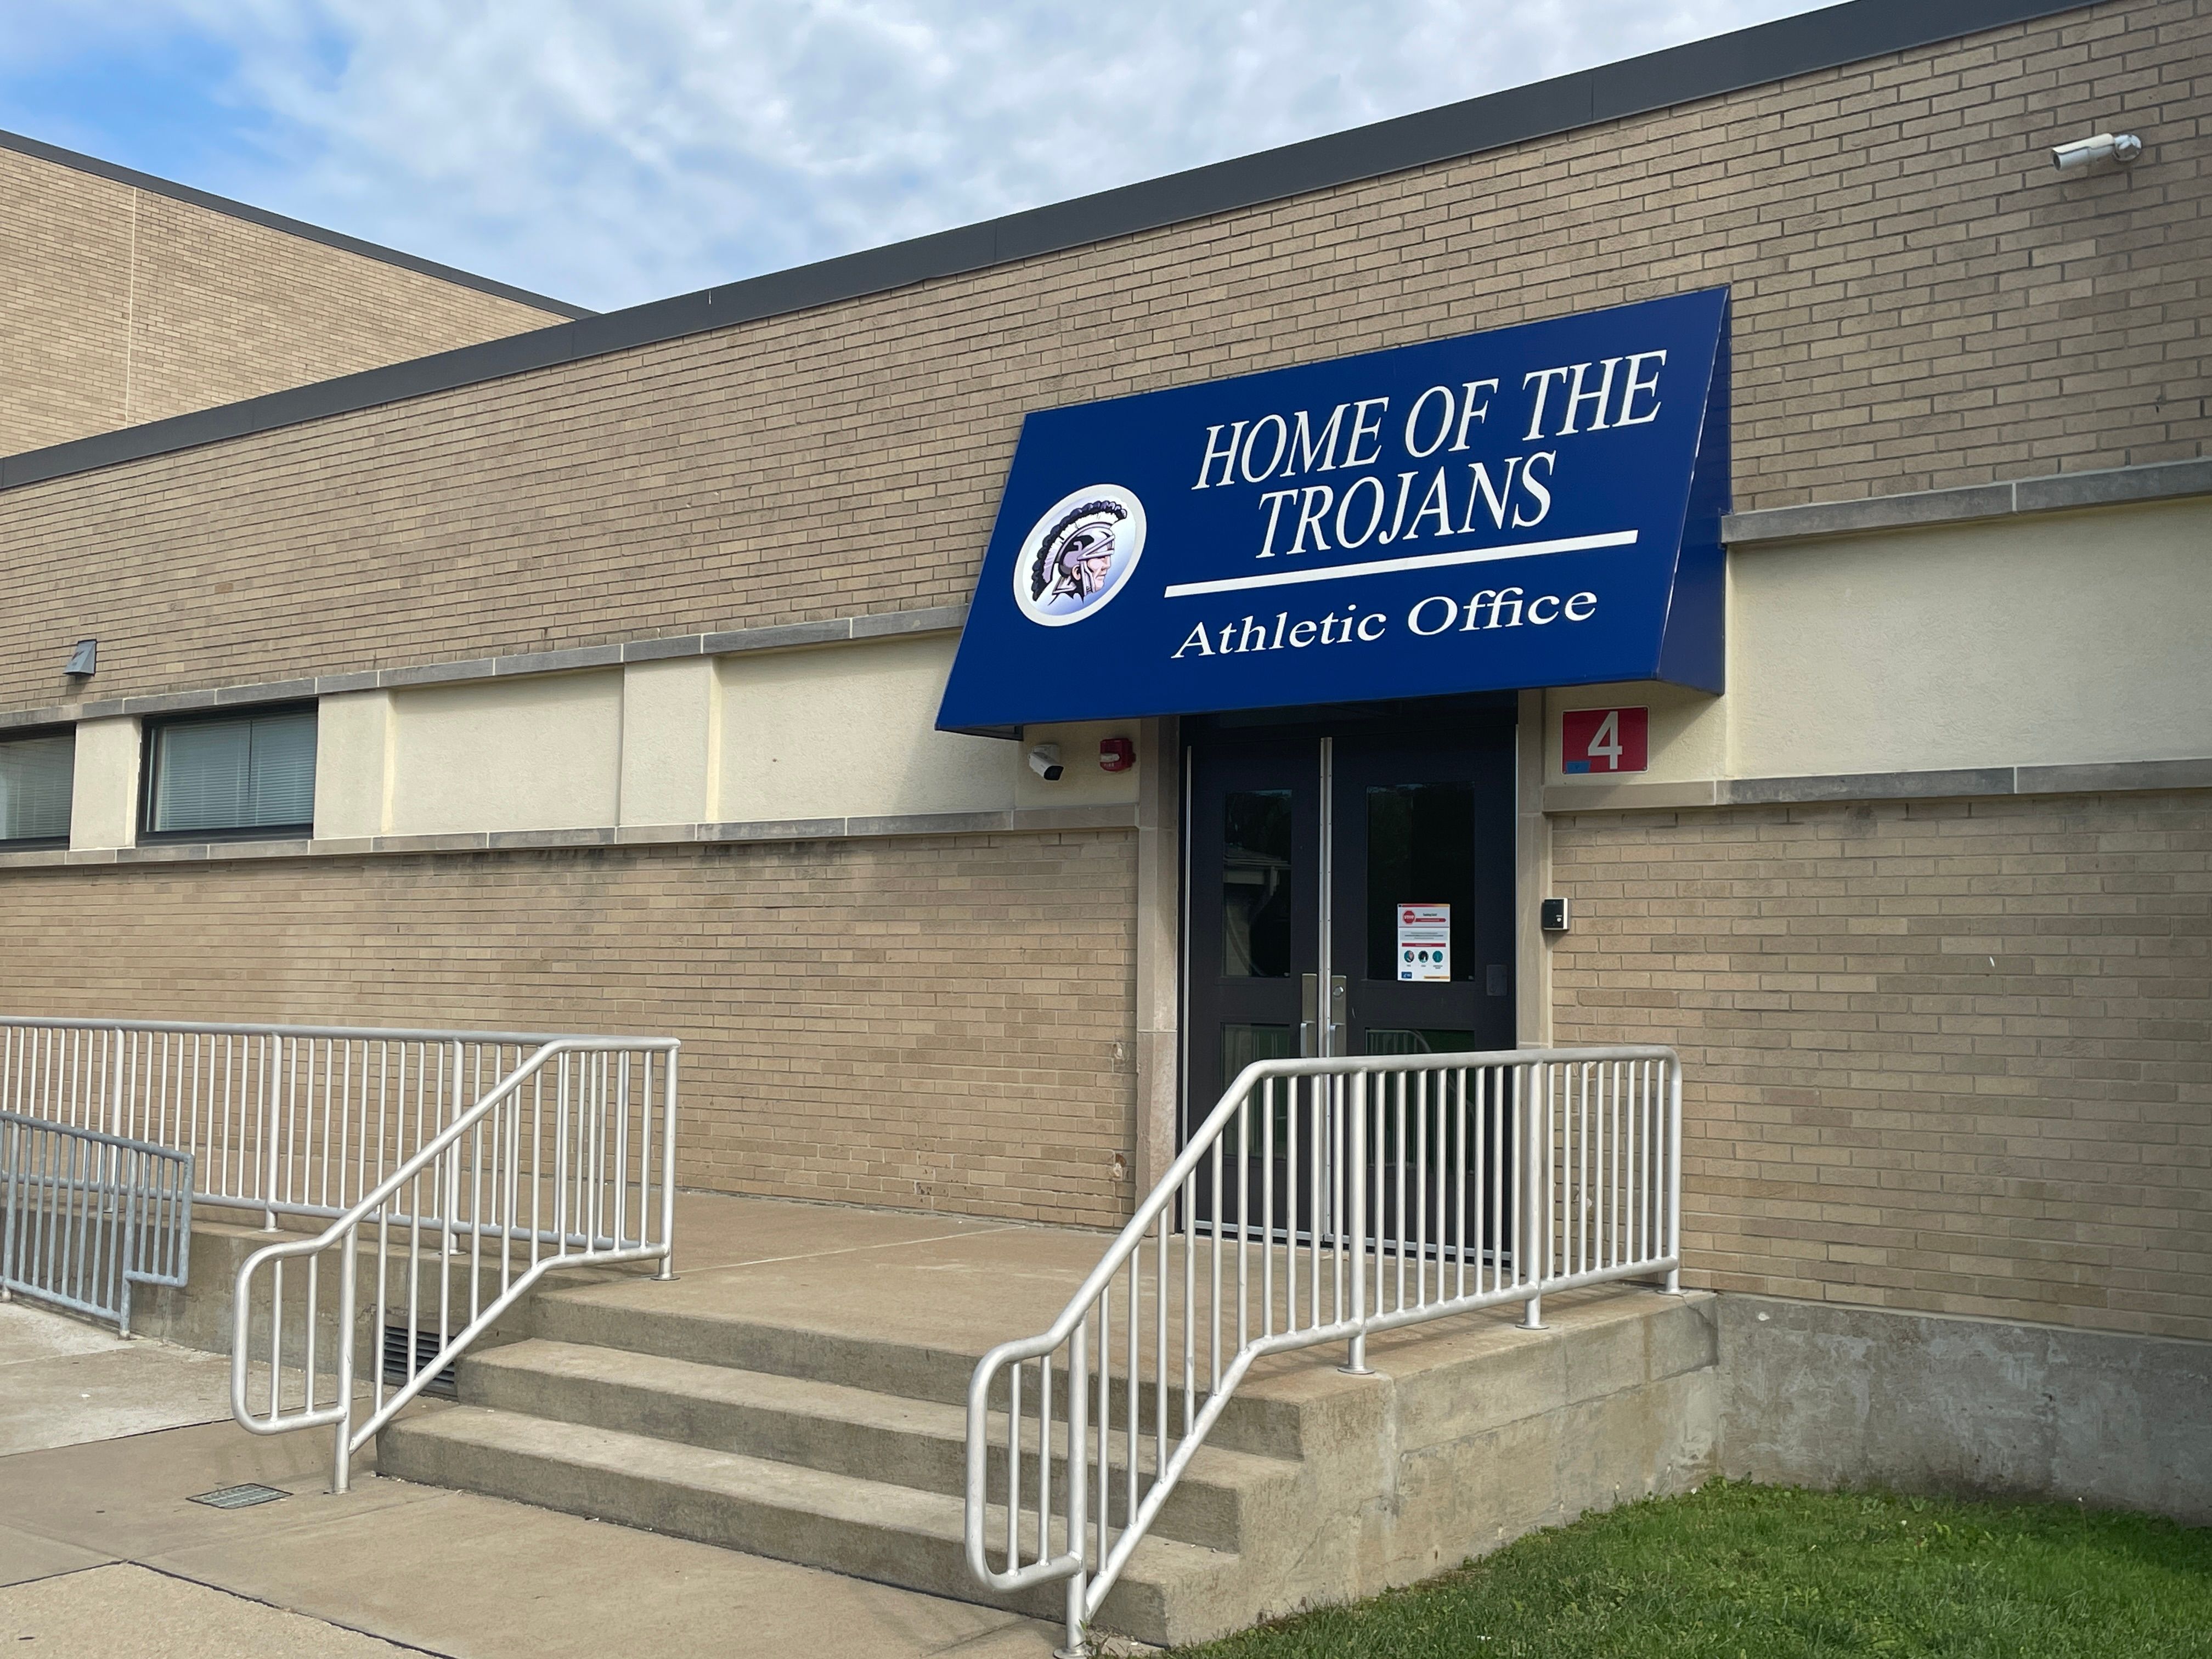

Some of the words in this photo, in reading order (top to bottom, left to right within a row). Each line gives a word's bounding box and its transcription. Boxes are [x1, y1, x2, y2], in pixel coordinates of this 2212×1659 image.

[1191, 396, 1390, 490] HOME
[1405, 378, 1499, 458] OF
[1522, 349, 1667, 441] THE
[1255, 450, 1556, 558] TROJANS
[1171, 604, 1386, 659] Athletic
[1408, 587, 1597, 635] Office
[1588, 711, 1623, 770] 4
